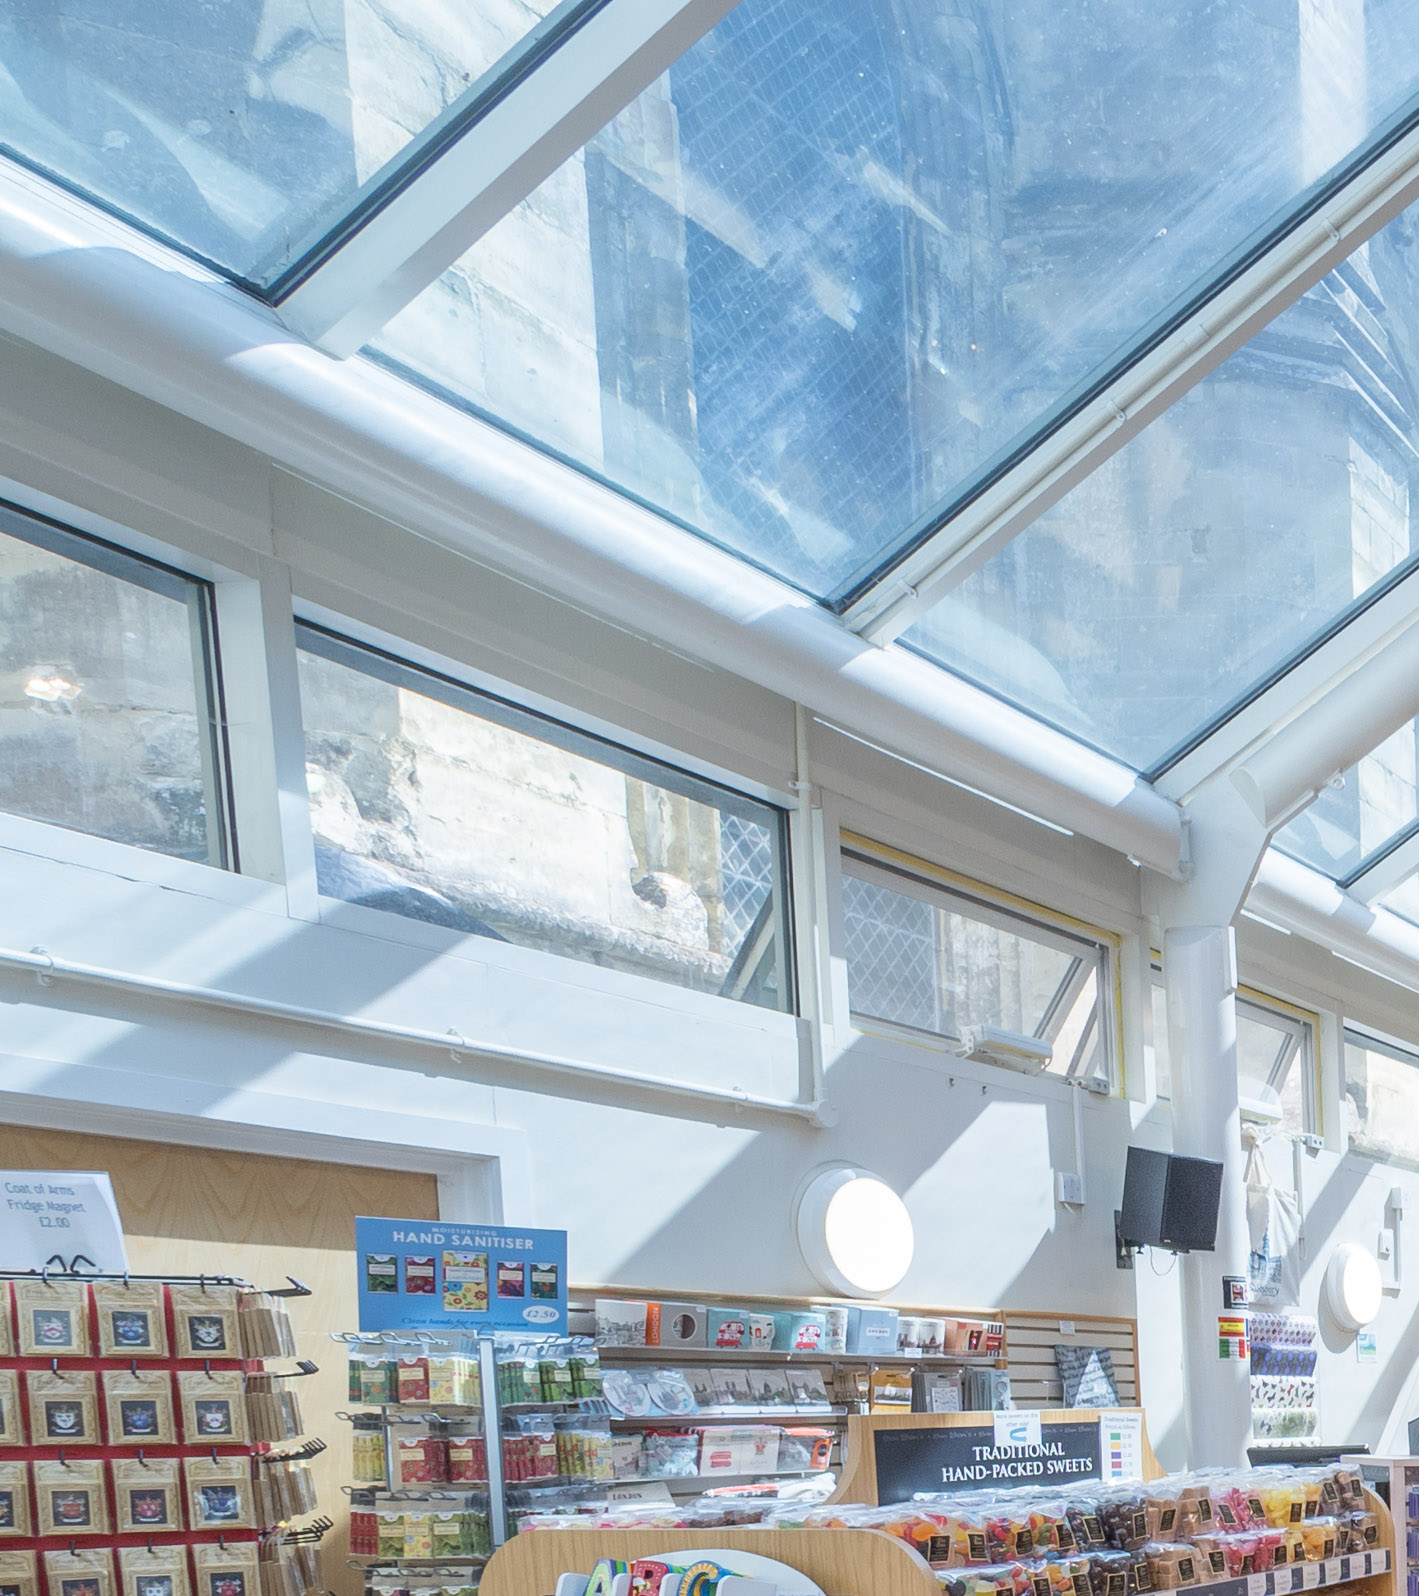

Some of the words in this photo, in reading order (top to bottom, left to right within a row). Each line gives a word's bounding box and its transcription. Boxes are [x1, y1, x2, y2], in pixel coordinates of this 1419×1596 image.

[5, 1182, 32, 1194] Coat
[34, 1184, 44, 1194] of
[48, 1185, 75, 1195] Arms
[7, 1199, 44, 1213] Fridge
[46, 1201, 87, 1214] Magnet
[40, 1217, 71, 1228] £2.00
[393, 1231, 445, 1245] HAND
[452, 1235, 534, 1250] SANITISER
[526, 1310, 556, 1319] £2.50
[972, 1442, 1065, 1461] TRADITIONAL
[942, 1461, 1043, 1483] HAND-PACKED
[1047, 1457, 1092, 1474] SWEETS
